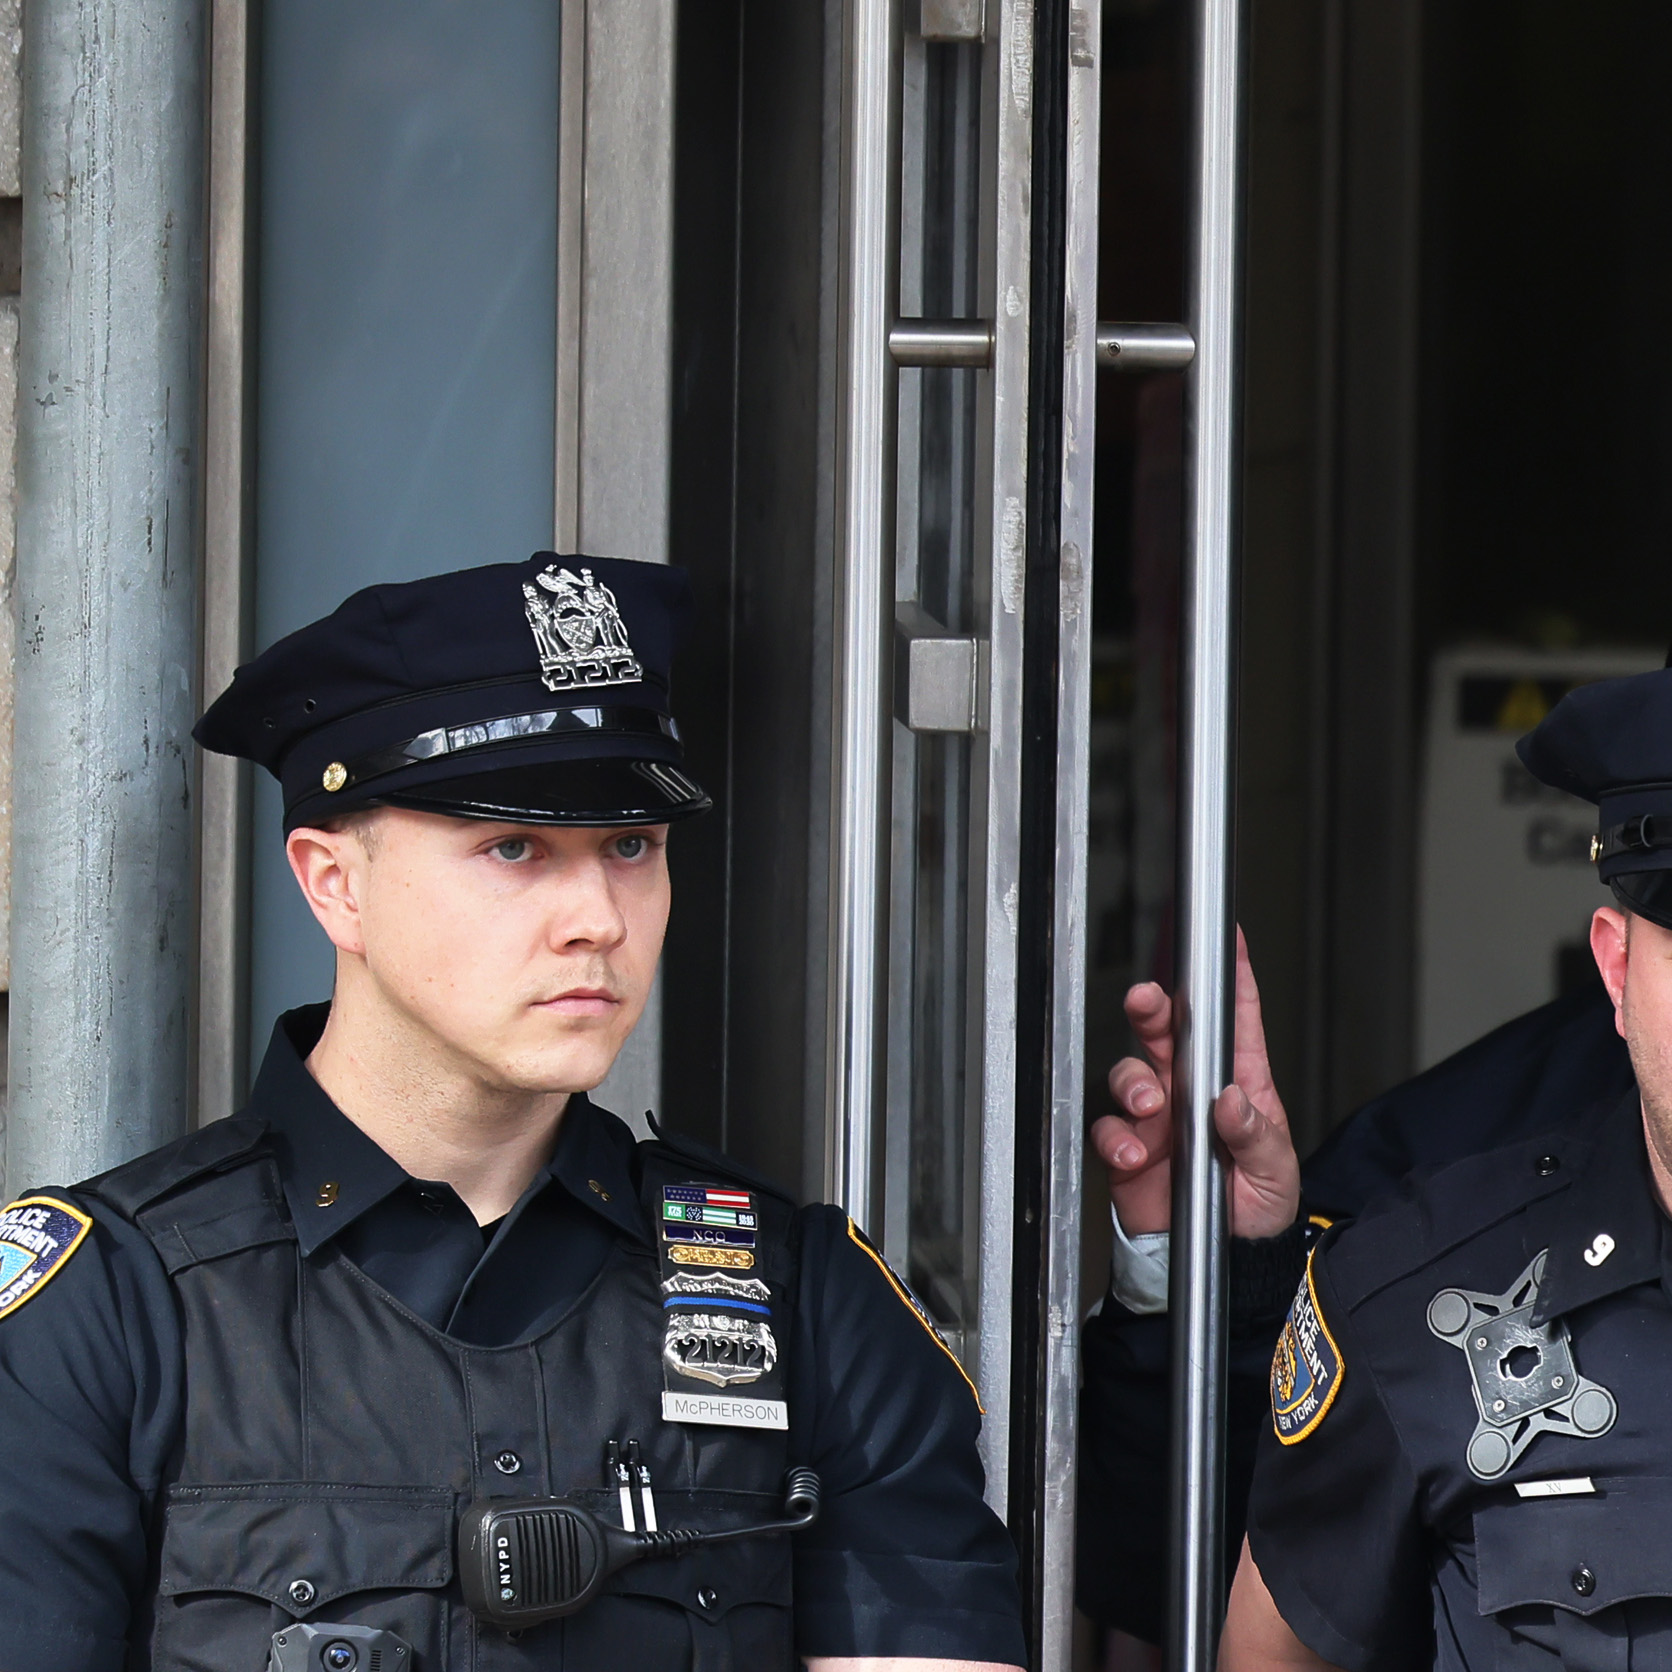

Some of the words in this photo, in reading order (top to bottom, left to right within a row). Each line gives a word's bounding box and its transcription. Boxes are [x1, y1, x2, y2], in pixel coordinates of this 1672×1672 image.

[542, 658, 642, 691] 21212
[316, 1181, 339, 1207] 9
[1584, 1233, 1616, 1267] 9
[682, 1332, 764, 1369] 21212
[674, 1399, 779, 1421] McPHERSON
[1290, 1391, 1319, 1425] YORK
[497, 1537, 511, 1584] NYPD
